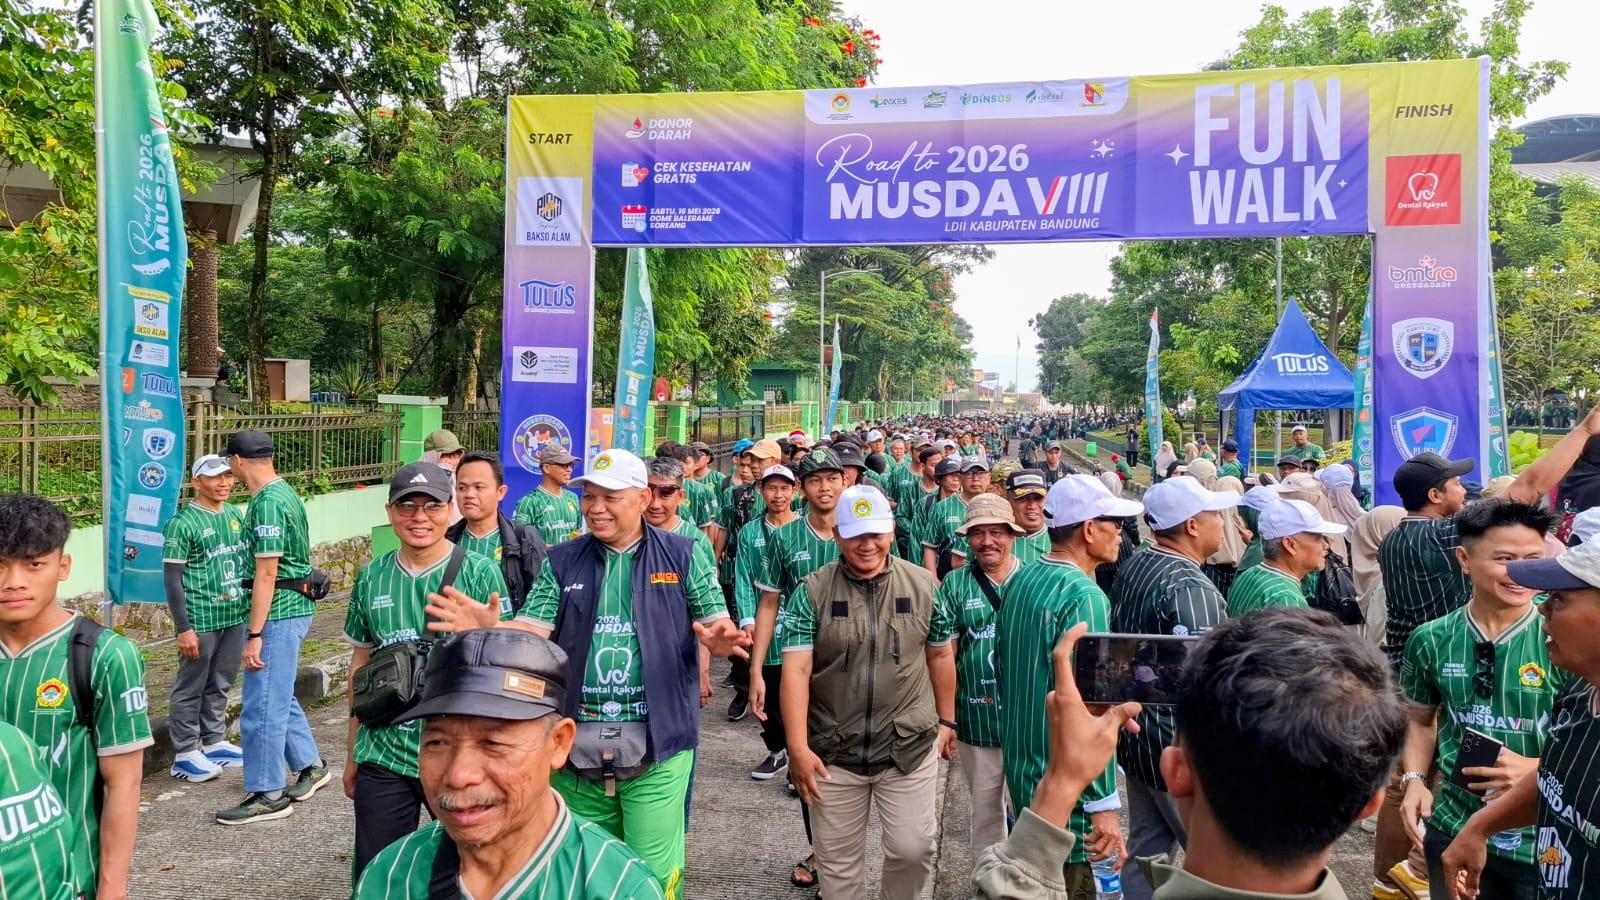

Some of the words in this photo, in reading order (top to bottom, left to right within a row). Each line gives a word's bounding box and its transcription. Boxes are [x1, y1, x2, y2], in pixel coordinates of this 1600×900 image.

[1395, 103, 1453, 119] FINISH
[649, 118, 693, 129] DONOR
[1193, 77, 1341, 167] FUN
[529, 133, 574, 145] START
[649, 129, 691, 140] DARAH
[139, 133, 153, 181] 2026
[816, 133, 917, 184] Road
[913, 141, 941, 172] to
[947, 143, 1029, 174] 2026
[654, 162, 678, 173] CEK
[679, 161, 751, 173] KESEHATAN
[654, 173, 697, 184] GRATIS
[153, 142, 170, 252] MUSDA
[830, 178, 1020, 219] MUSDA
[1026, 172, 1109, 215] VIII
[1189, 164, 1337, 225] WALK
[1423, 201, 1448, 210] Rakyat
[945, 220, 967, 232] LDII
[969, 219, 1036, 231] KABUPATEN
[1040, 217, 1100, 230] BANDUNG
[526, 231, 549, 241] BAKSO
[551, 232, 571, 242] ALAM
[1388, 265, 1457, 282] bmtra
[519, 279, 575, 308] TULUS
[1271, 352, 1329, 373] TULUS
[141, 372, 177, 394] TULU
[593, 623, 633, 633] USDA
[598, 616, 621, 624] 2026
[395, 628, 417, 638] 2026
[581, 685, 610, 694] Dental
[1458, 711, 1507, 729] MUSDA
[1546, 772, 1564, 796] 2026
